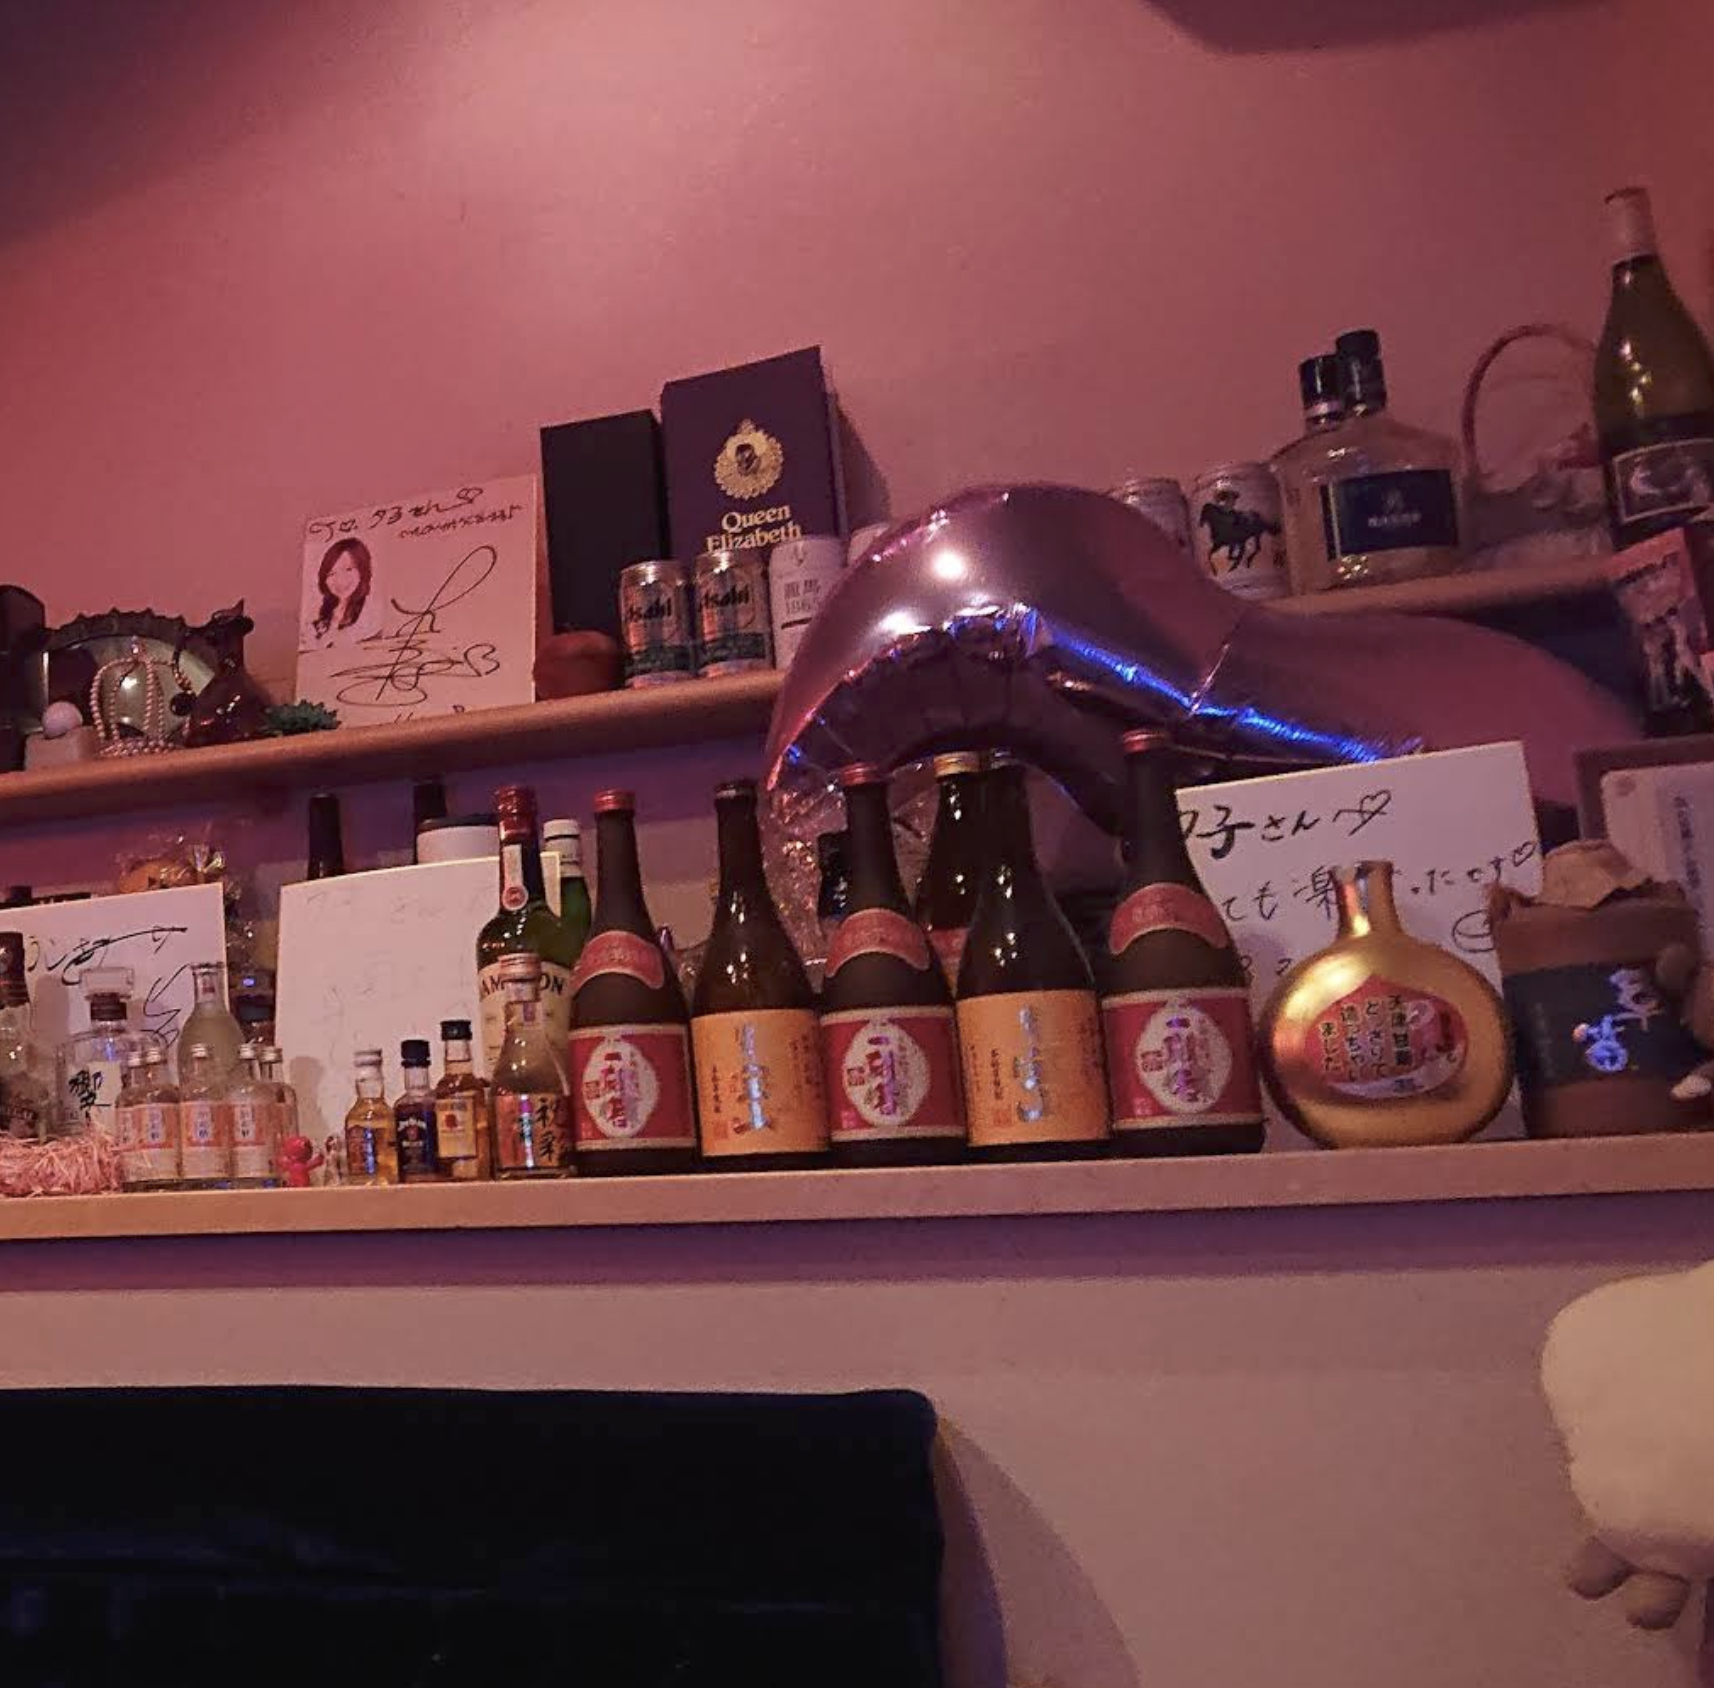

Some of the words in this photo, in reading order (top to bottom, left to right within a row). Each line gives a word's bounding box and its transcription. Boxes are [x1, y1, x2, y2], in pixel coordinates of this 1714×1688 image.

[722, 505, 791, 533] Queen
[706, 521, 802, 552] Elizabeth
[626, 597, 672, 620] Asahi
[699, 585, 749, 612] Asahi
